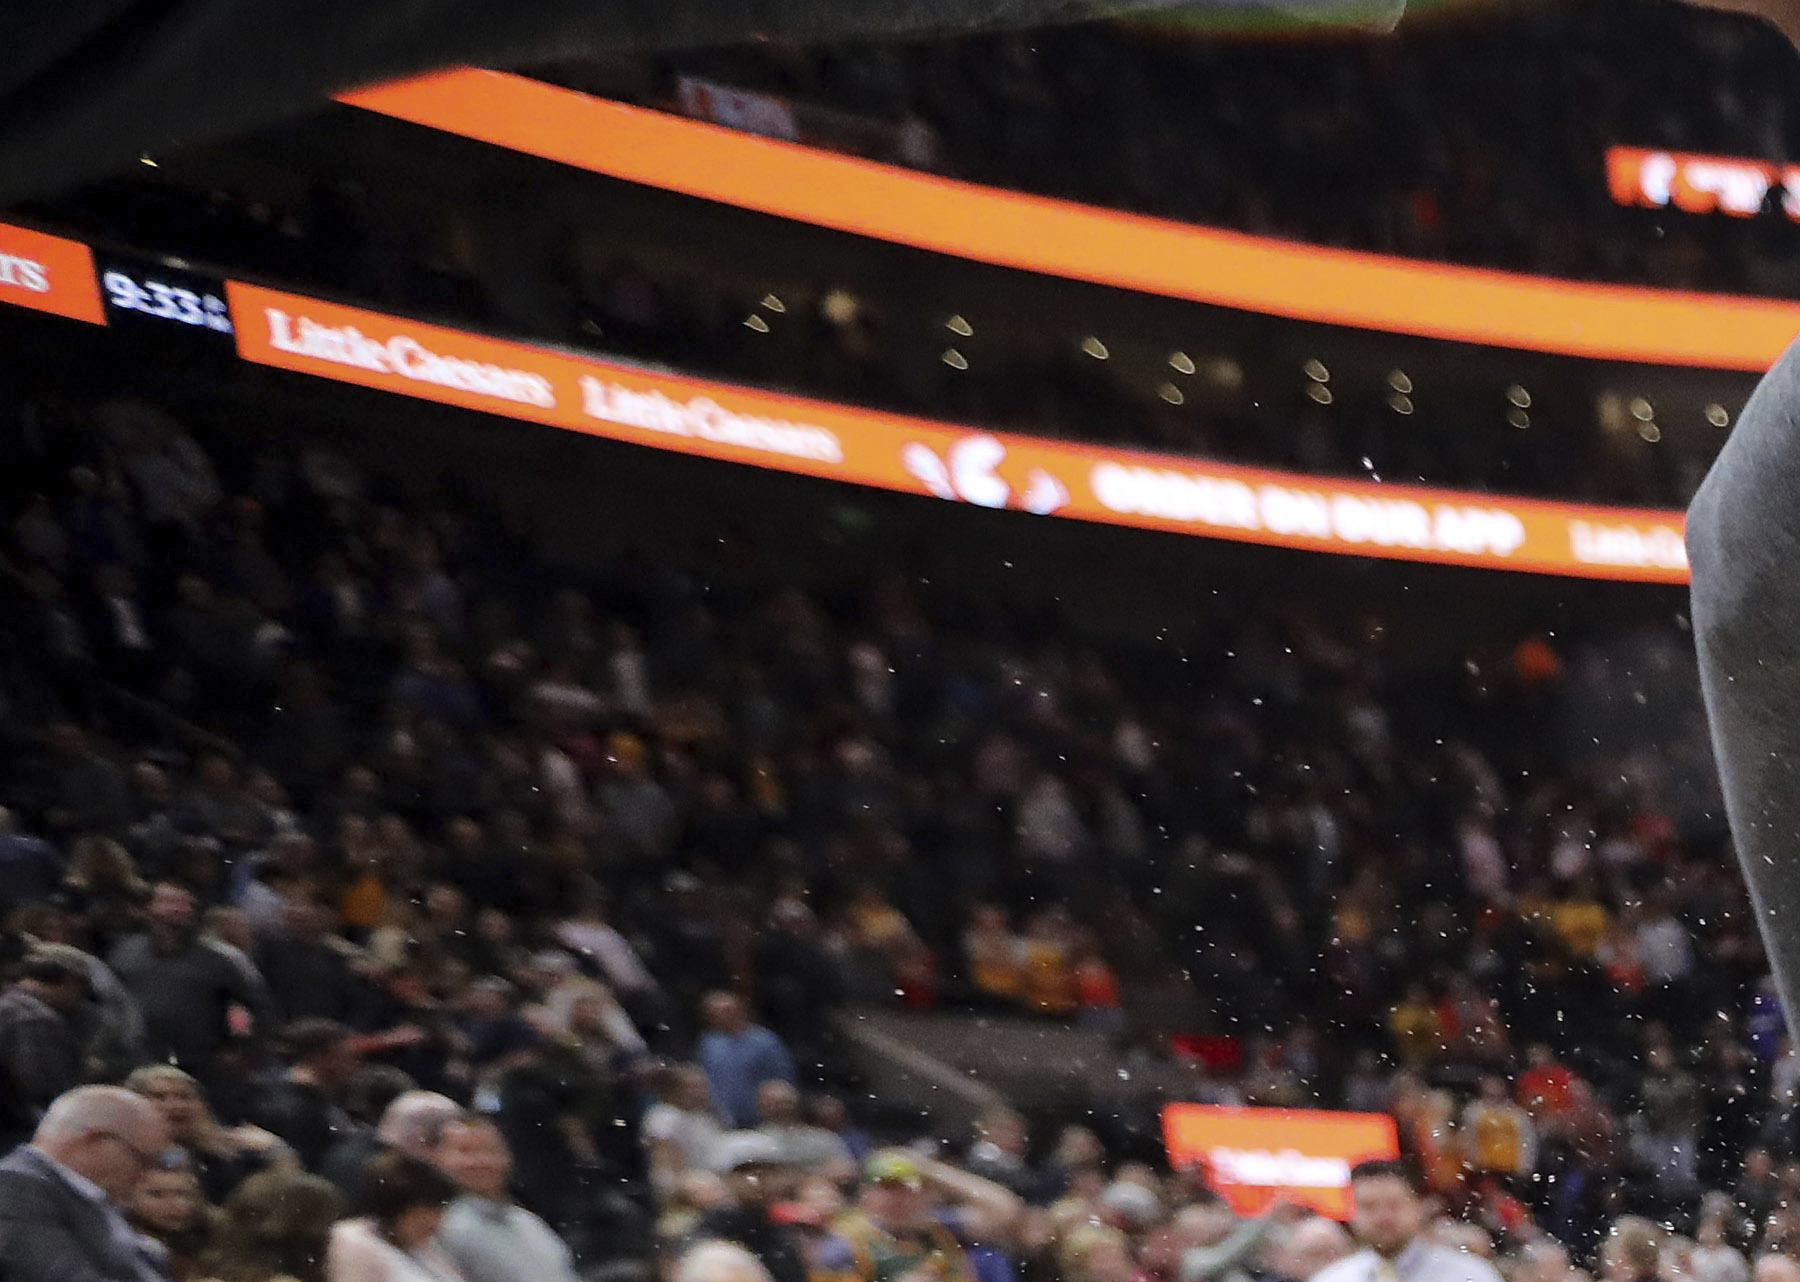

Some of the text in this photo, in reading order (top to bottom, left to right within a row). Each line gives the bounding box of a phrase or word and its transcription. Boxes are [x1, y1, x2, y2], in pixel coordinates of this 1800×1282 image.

[264, 307, 394, 374] Little
[387, 335, 557, 409] Caesars
[577, 374, 844, 463] Little Caesars
[1091, 461, 1261, 532] ORDER
[1259, 484, 1331, 540] ON
